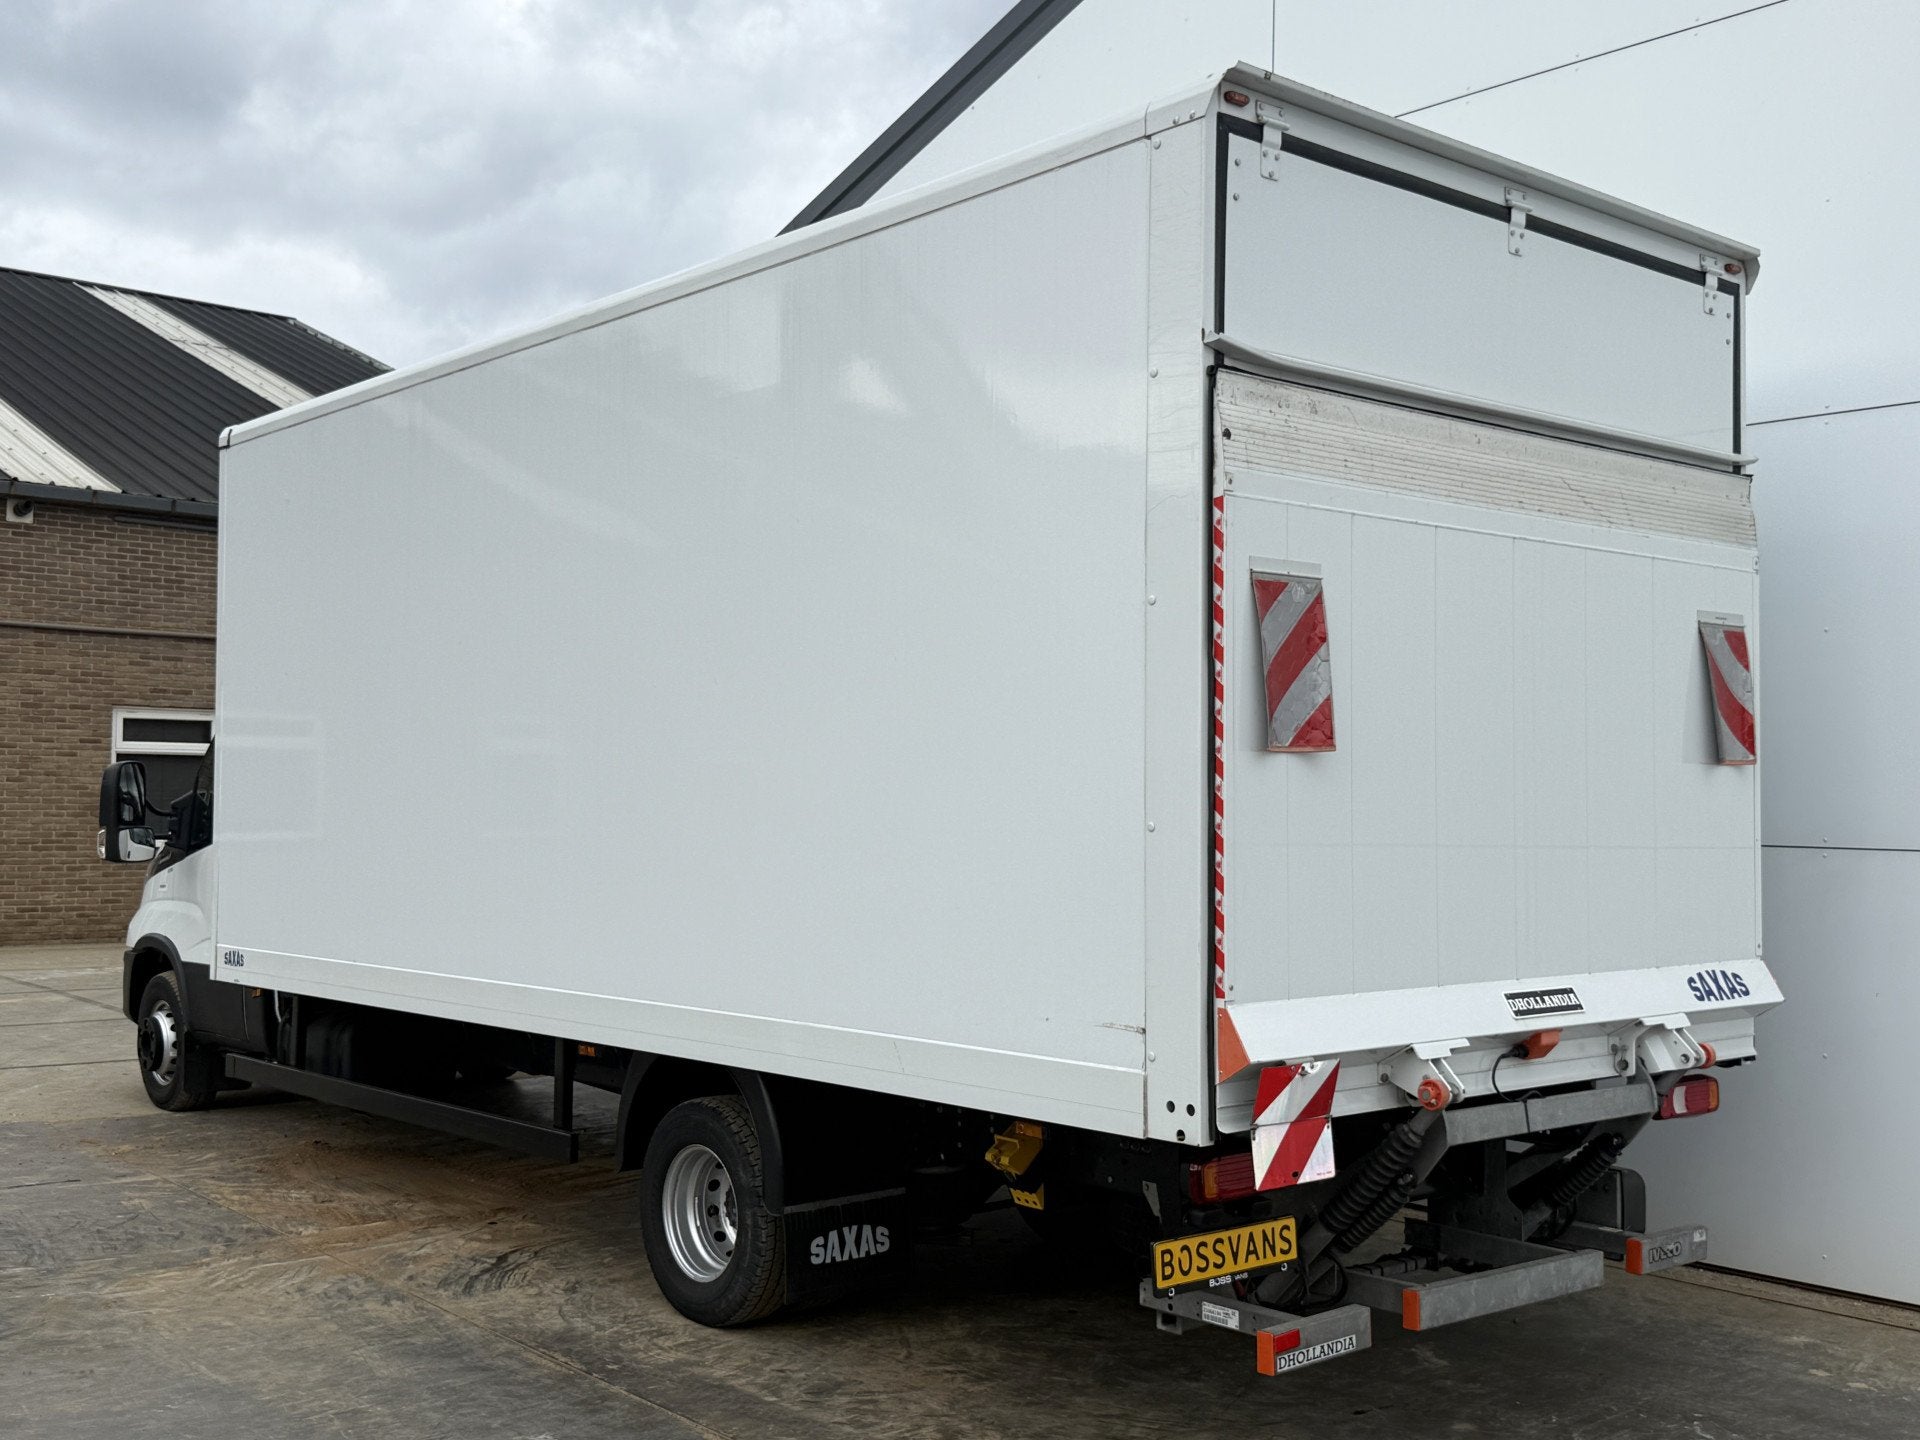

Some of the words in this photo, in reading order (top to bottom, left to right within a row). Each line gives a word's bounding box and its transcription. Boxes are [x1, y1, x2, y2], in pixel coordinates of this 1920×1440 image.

[223, 950, 245, 967] SAXAS
[1508, 992, 1580, 1012] DHOLLANDIA
[1687, 969, 1751, 1002] SAXAS
[810, 1224, 891, 1265] SAXAS
[1160, 1224, 1293, 1281] BOSSVANS
[1209, 1274, 1232, 1288] BOSS
[1278, 1337, 1355, 1371] DHOLLANDIA
